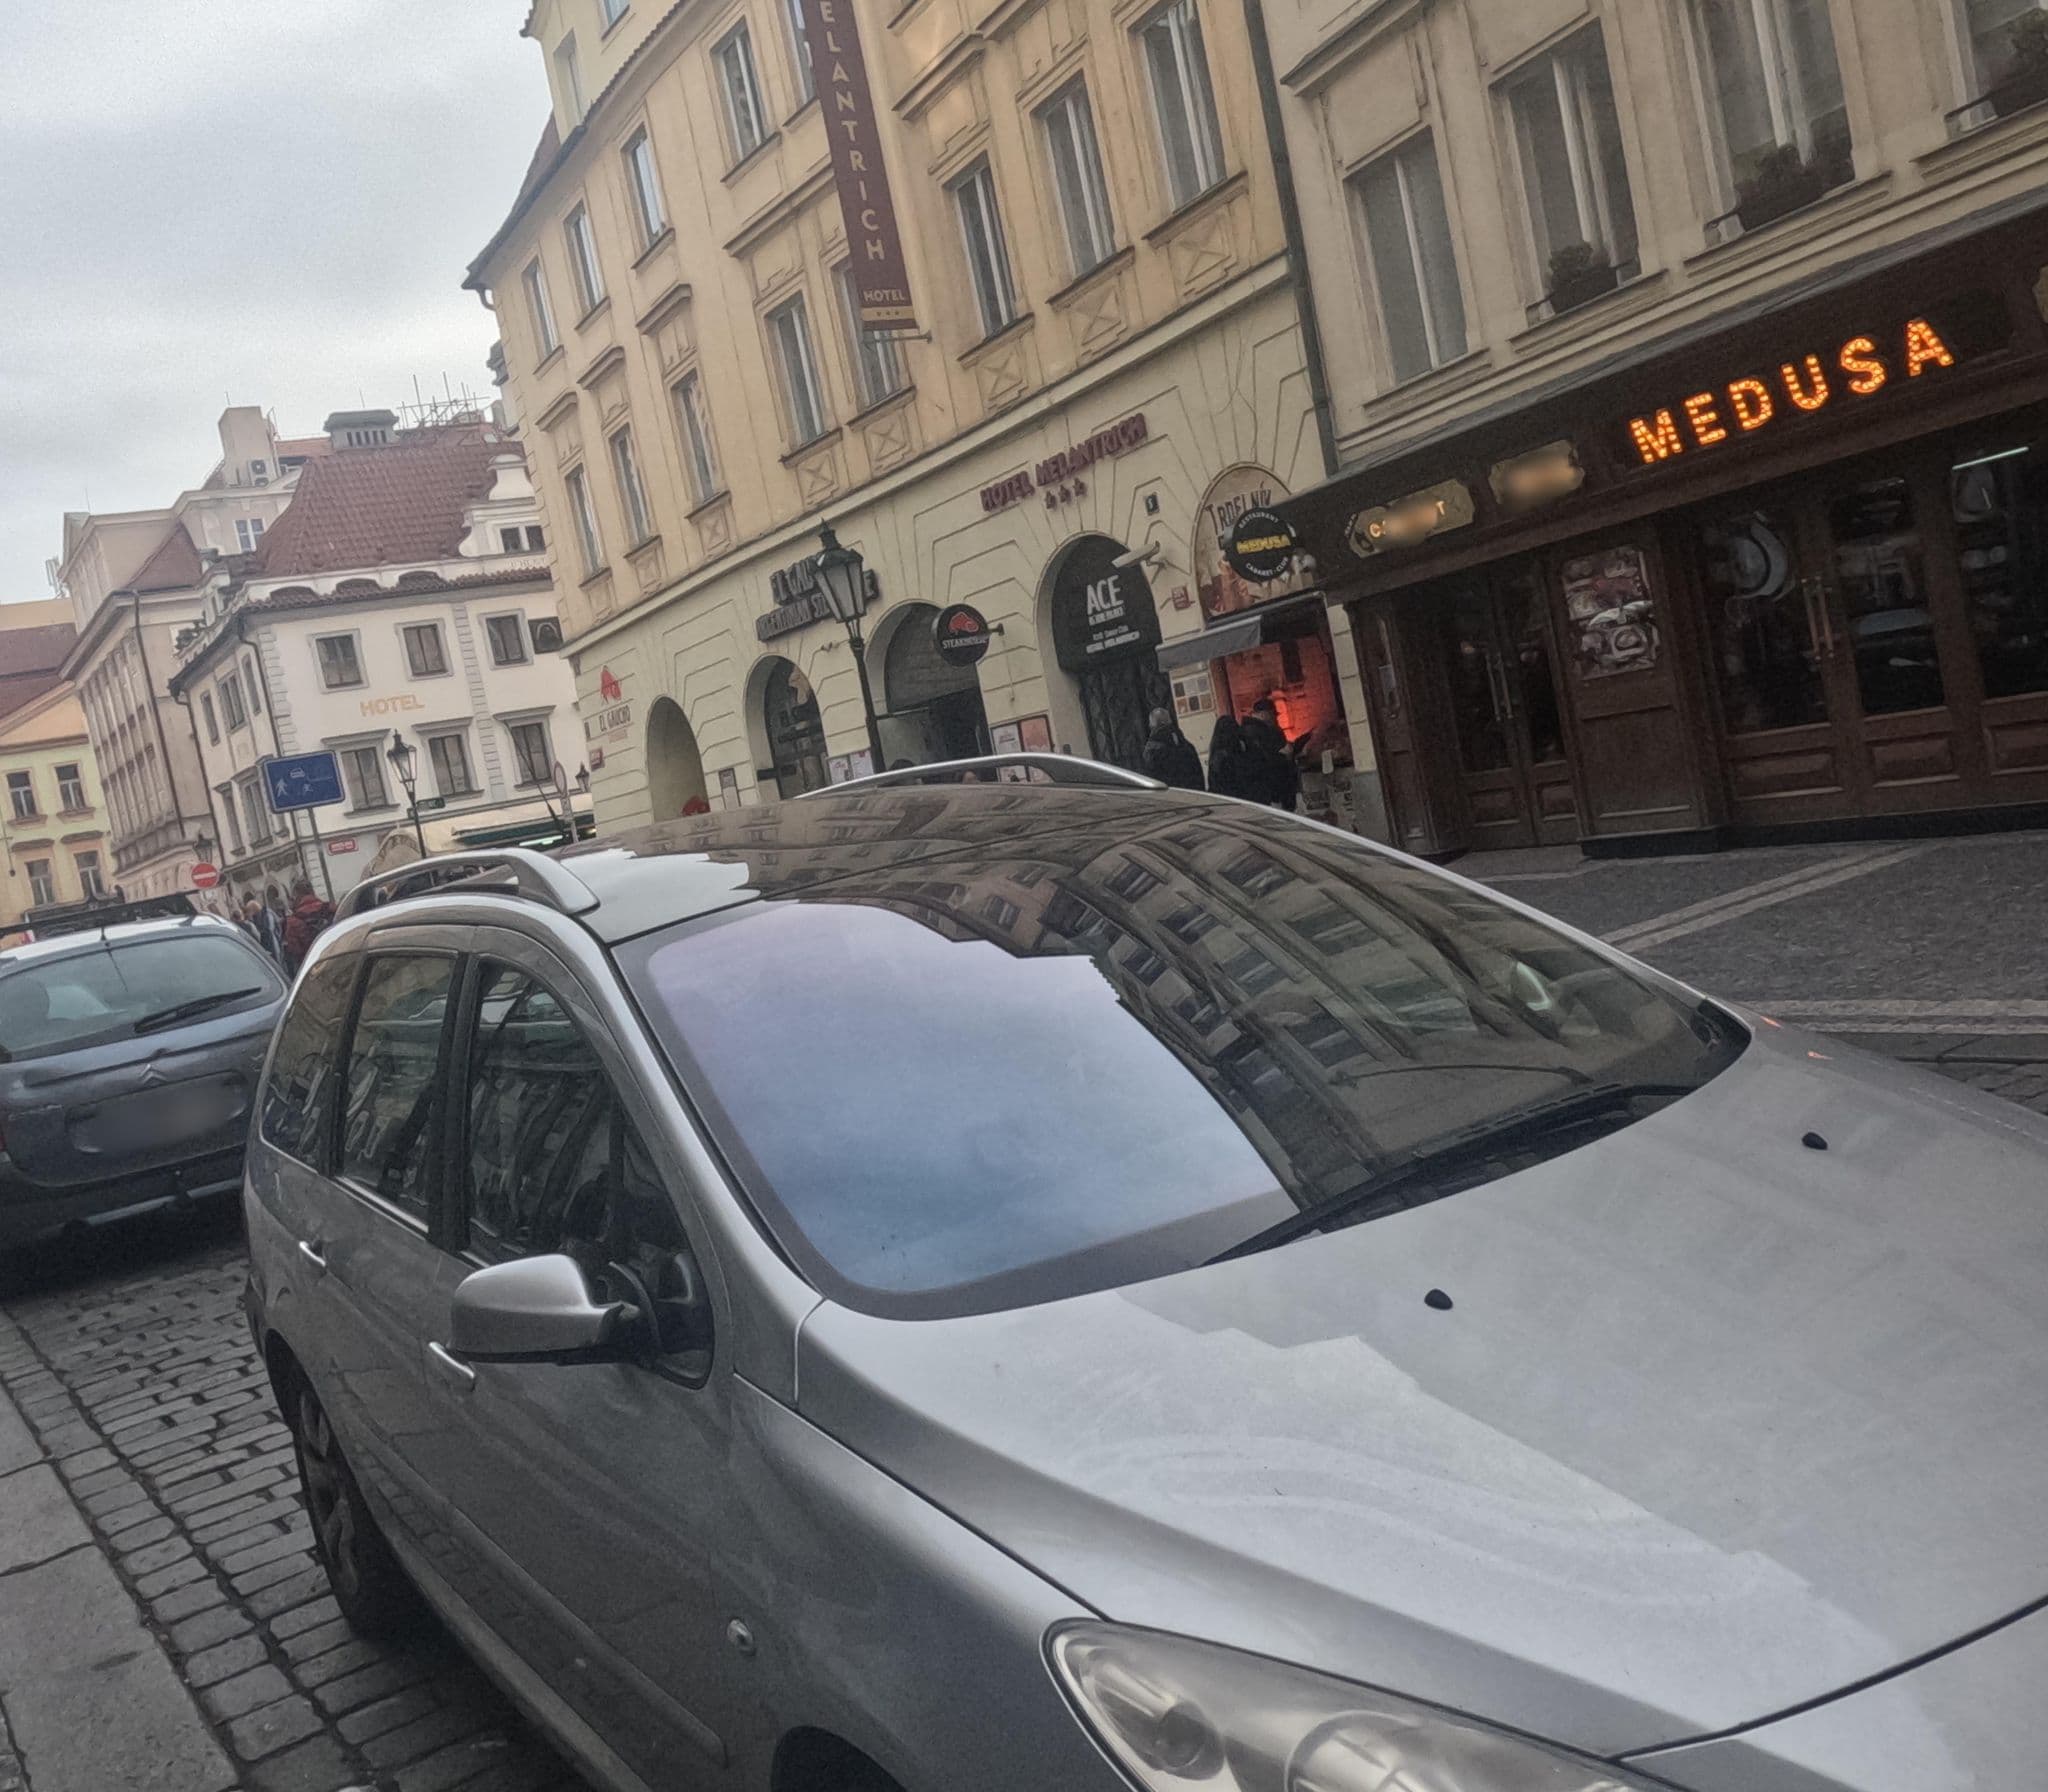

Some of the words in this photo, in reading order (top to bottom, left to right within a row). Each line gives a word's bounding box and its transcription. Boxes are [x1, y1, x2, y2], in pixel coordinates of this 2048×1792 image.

[863, 289, 905, 302] HOTEL
[1629, 317, 1954, 464] MEDUSA
[980, 471, 1035, 512] HOTEL
[1238, 511, 1279, 529] RESTAURANT
[1236, 534, 1291, 554] MEDUSA
[1087, 574, 1124, 615] ACE
[360, 694, 425, 717] HOTEL
